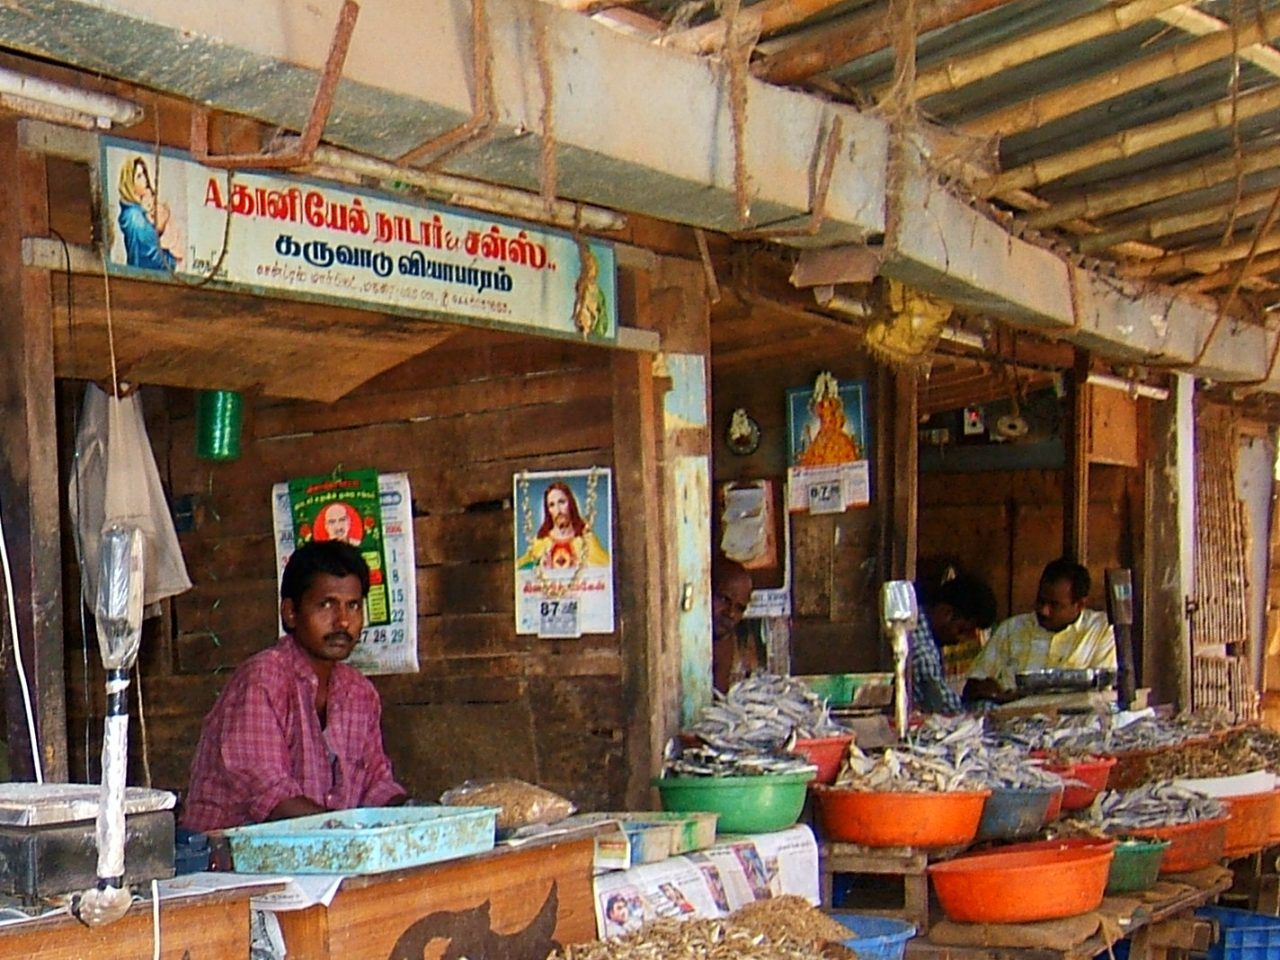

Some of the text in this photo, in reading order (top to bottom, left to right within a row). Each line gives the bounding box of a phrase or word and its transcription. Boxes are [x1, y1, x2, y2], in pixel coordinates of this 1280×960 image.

[372, 211, 443, 249] நாடார்
[274, 233, 394, 278] கருவாடு
[398, 249, 514, 294] வியாபாரம்
[391, 549, 397, 562] 1
[392, 568, 400, 583] 8
[391, 588, 405, 603] 15
[391, 608, 405, 623] 22
[373, 629, 387, 644] 28
[391, 628, 405, 645] 29
